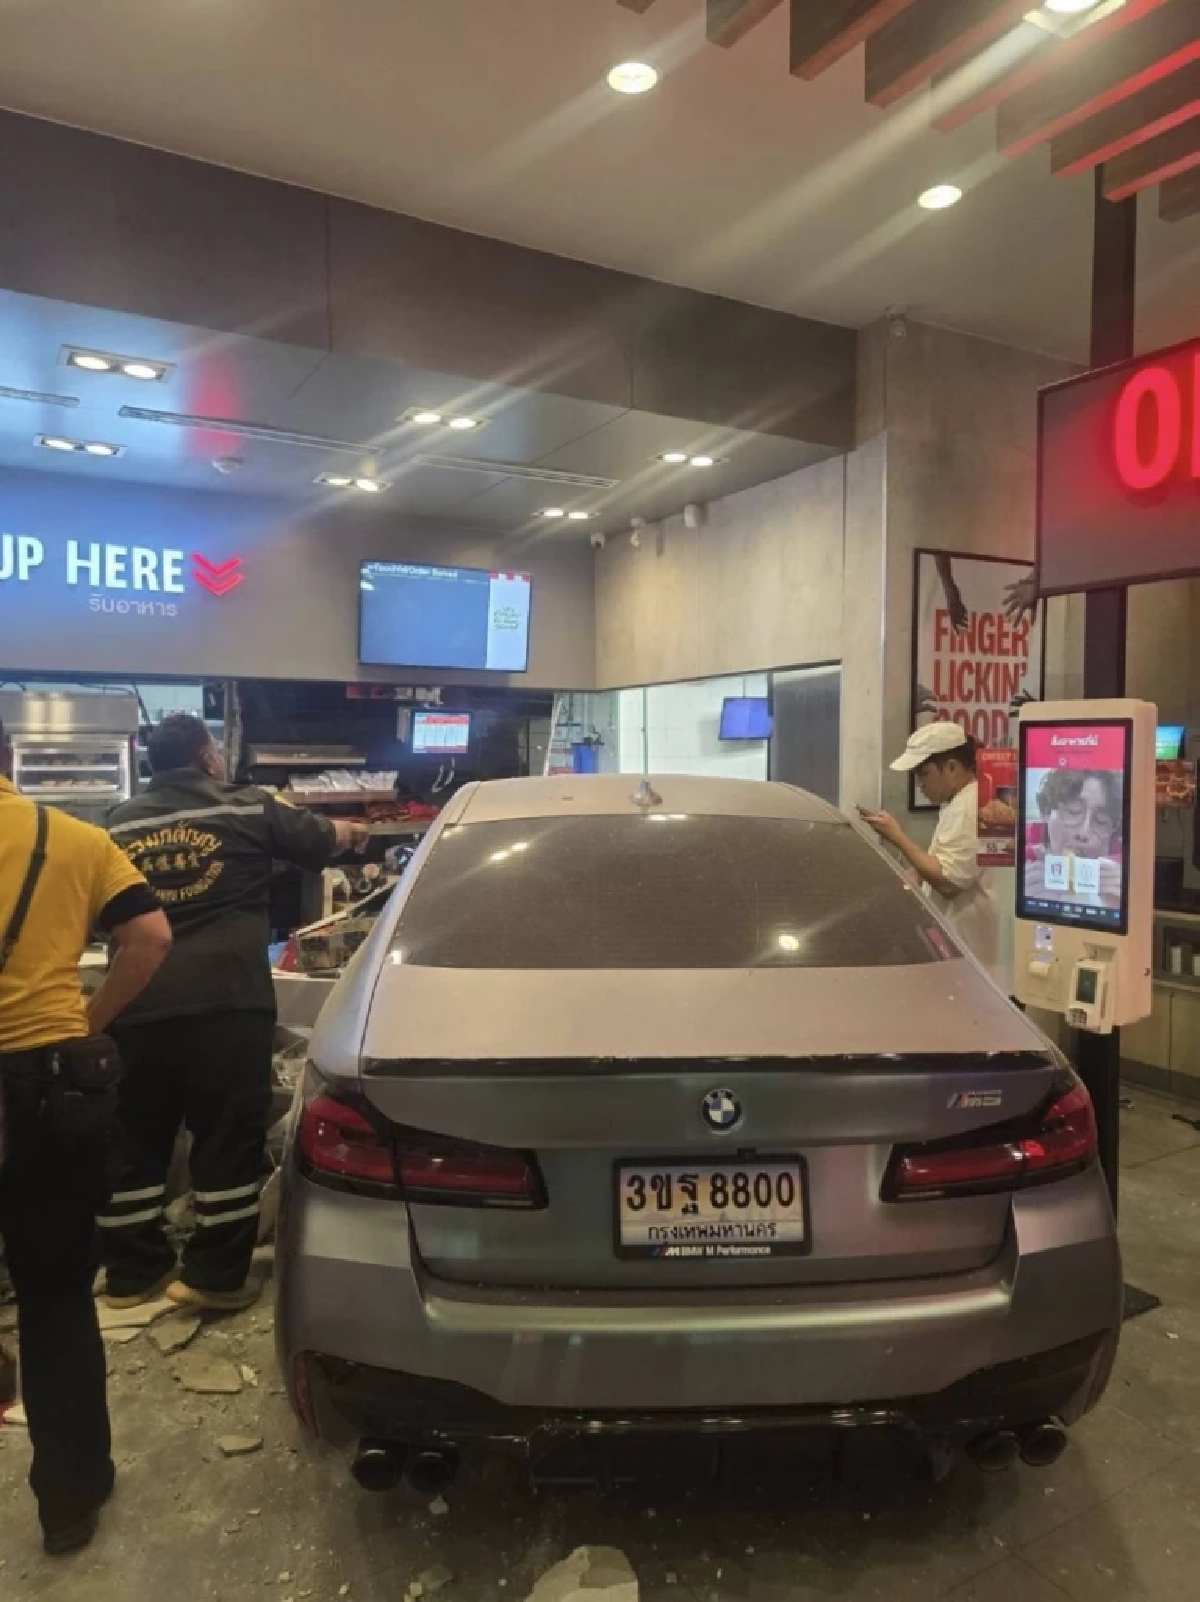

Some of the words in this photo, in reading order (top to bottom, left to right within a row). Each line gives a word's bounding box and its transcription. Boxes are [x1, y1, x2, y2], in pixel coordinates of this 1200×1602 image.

[1115, 353, 1200, 489] O
[66, 540, 185, 593] HERE
[934, 660, 1026, 702] LICKIN'
[626, 1173, 699, 1214] 3ขฐ
[709, 1172, 796, 1209] 8800
[648, 1223, 776, 1241] กรุงเทพมหานคร
[706, 1246, 714, 1257] M
[717, 1245, 771, 1257] Performance
